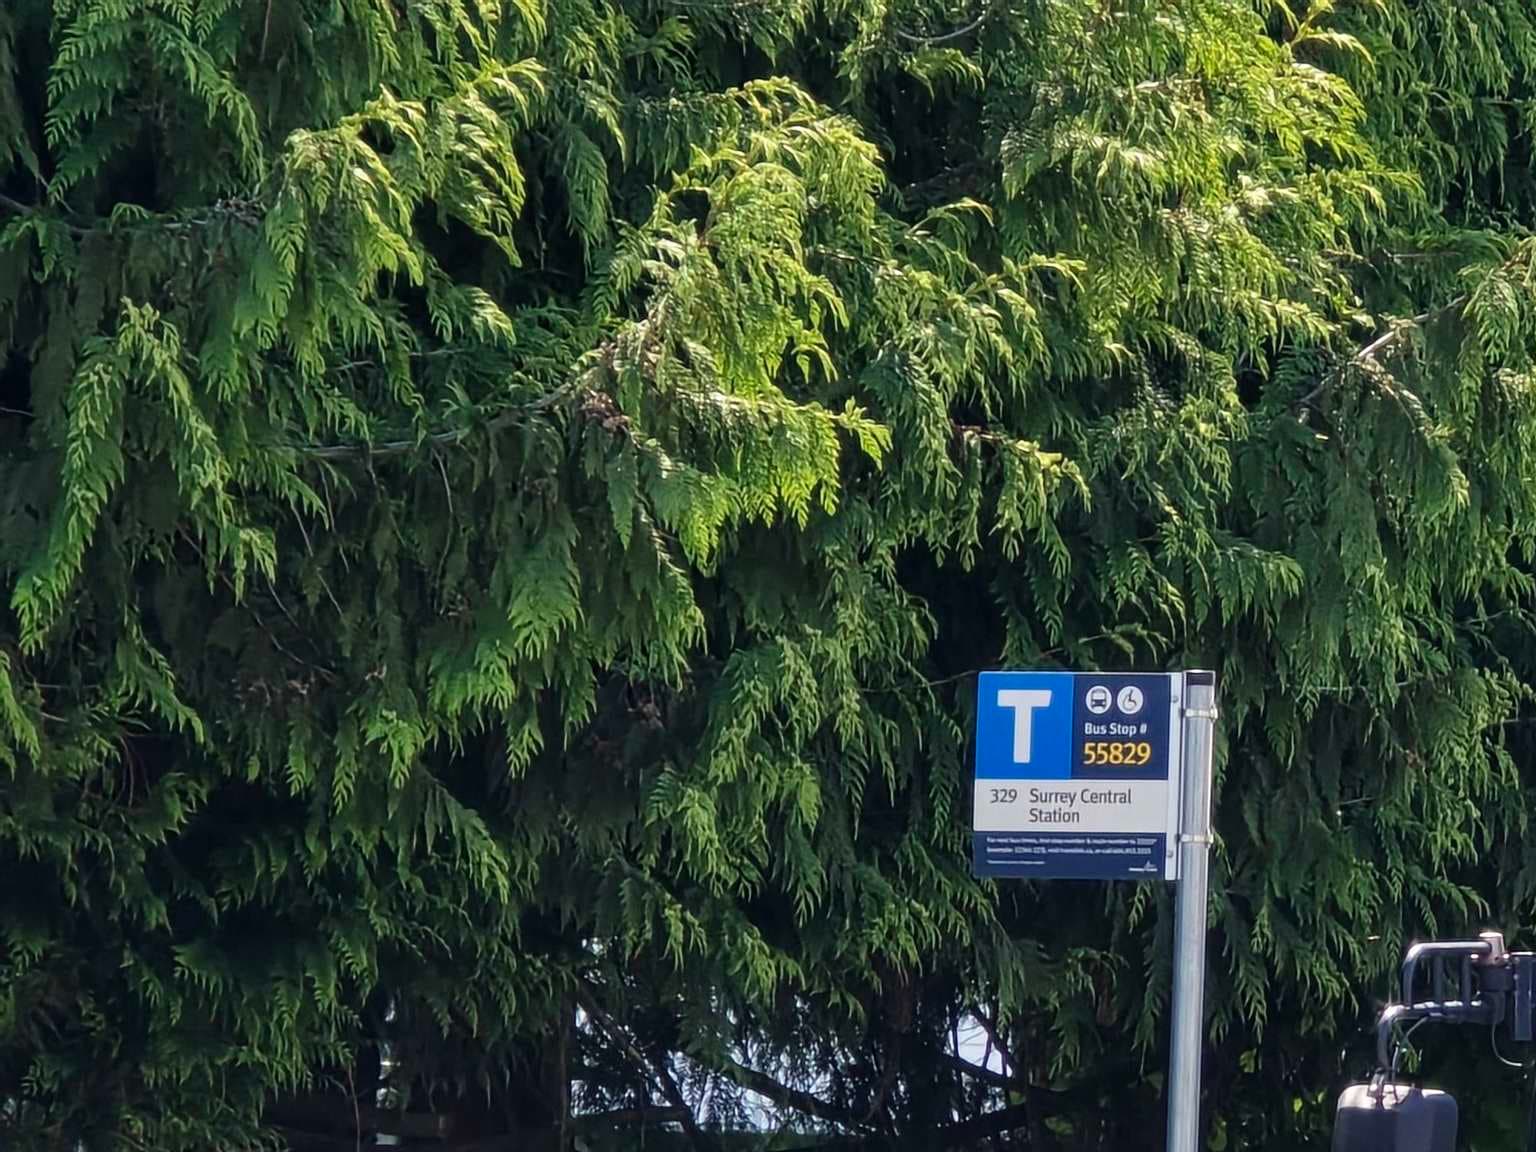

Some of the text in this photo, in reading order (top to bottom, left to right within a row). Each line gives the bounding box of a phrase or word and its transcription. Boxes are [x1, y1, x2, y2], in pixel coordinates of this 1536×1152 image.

[997, 689, 1052, 763] T
[1084, 722, 1148, 738] Bus Stop #
[1083, 742, 1151, 765] 55829
[989, 788, 1132, 807] 329 Surrey Central
[1029, 807, 1080, 823] Station
